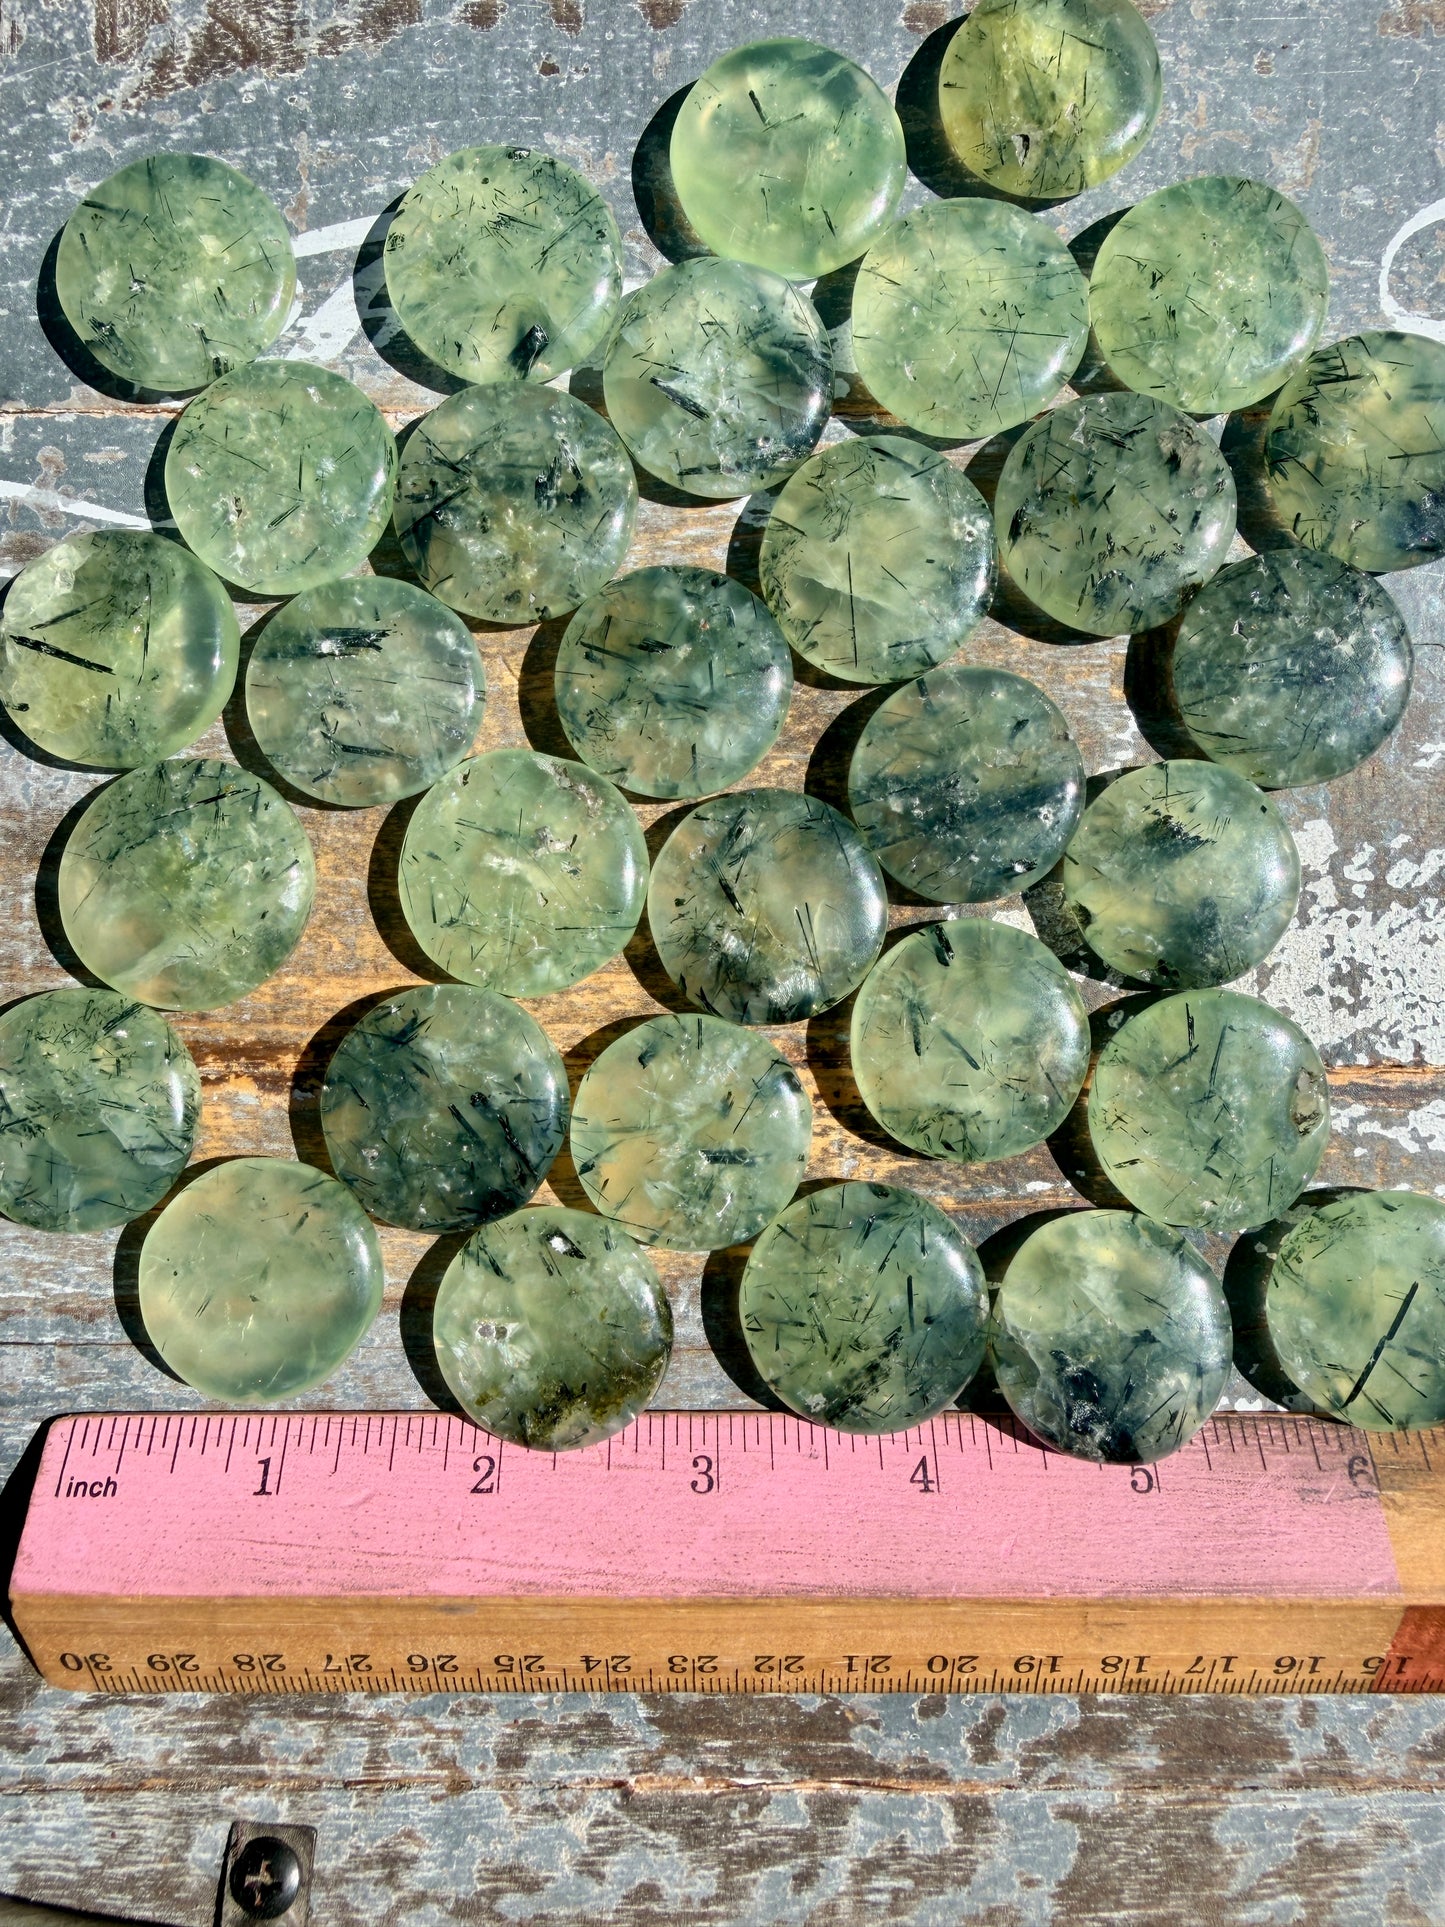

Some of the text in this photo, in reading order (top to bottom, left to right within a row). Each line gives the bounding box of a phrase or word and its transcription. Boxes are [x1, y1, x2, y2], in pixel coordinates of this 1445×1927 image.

[66, 1455, 1377, 1497] inch 1 2 3 4 5 6
[60, 1653, 1413, 1674] 15 16 17 18 19 20 21 22 23 24 25 26 27 28 29 30
